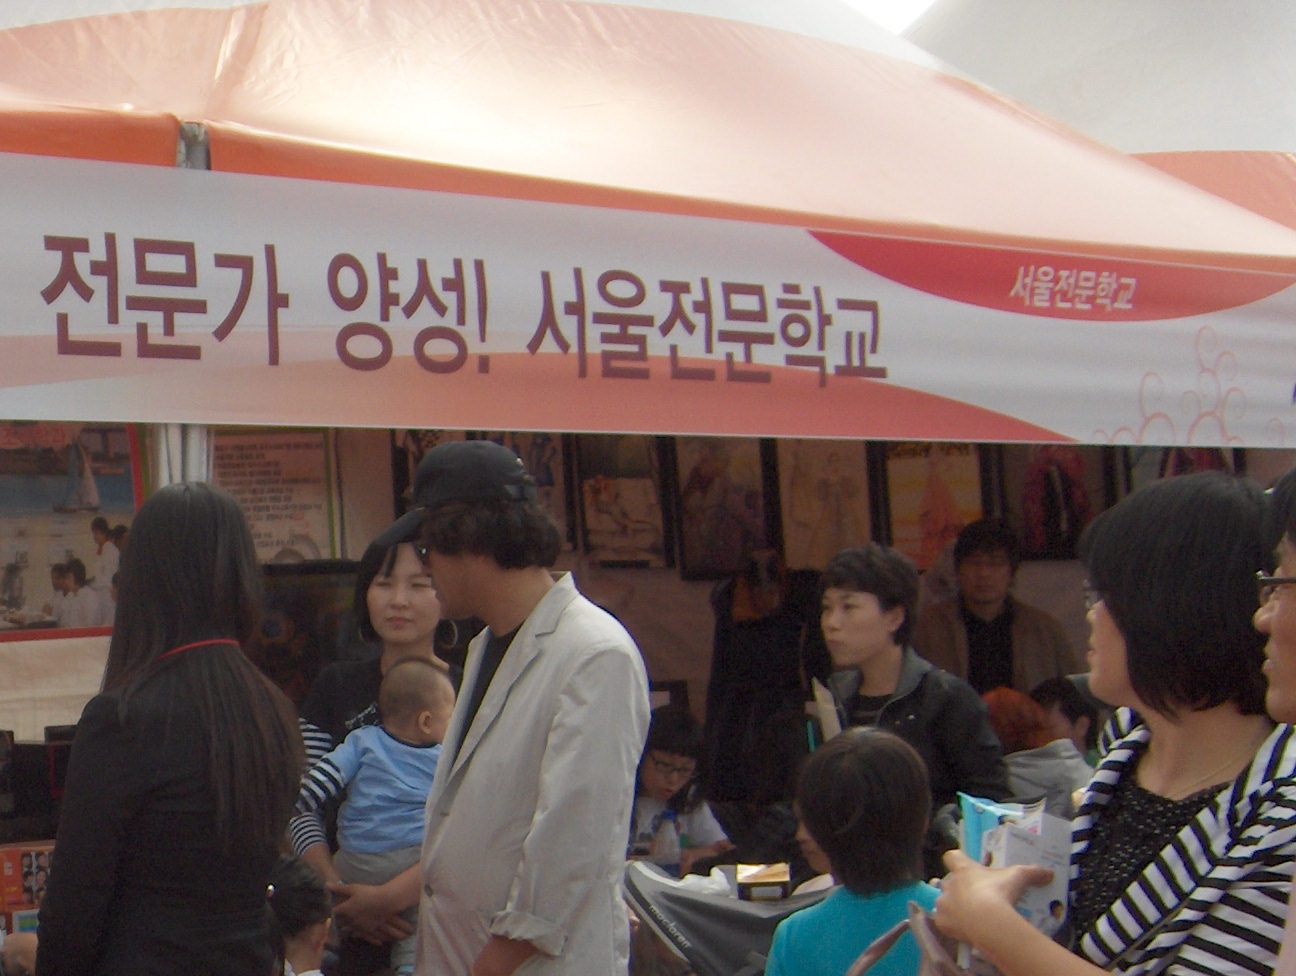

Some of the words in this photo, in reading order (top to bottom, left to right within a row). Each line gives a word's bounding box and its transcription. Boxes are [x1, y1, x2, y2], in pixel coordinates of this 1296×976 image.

[41, 231, 290, 366] 전문가
[327, 251, 490, 374] 양성!
[526, 267, 888, 387] 서울전문학교
[1009, 264, 1137, 313] 서울전문학교
